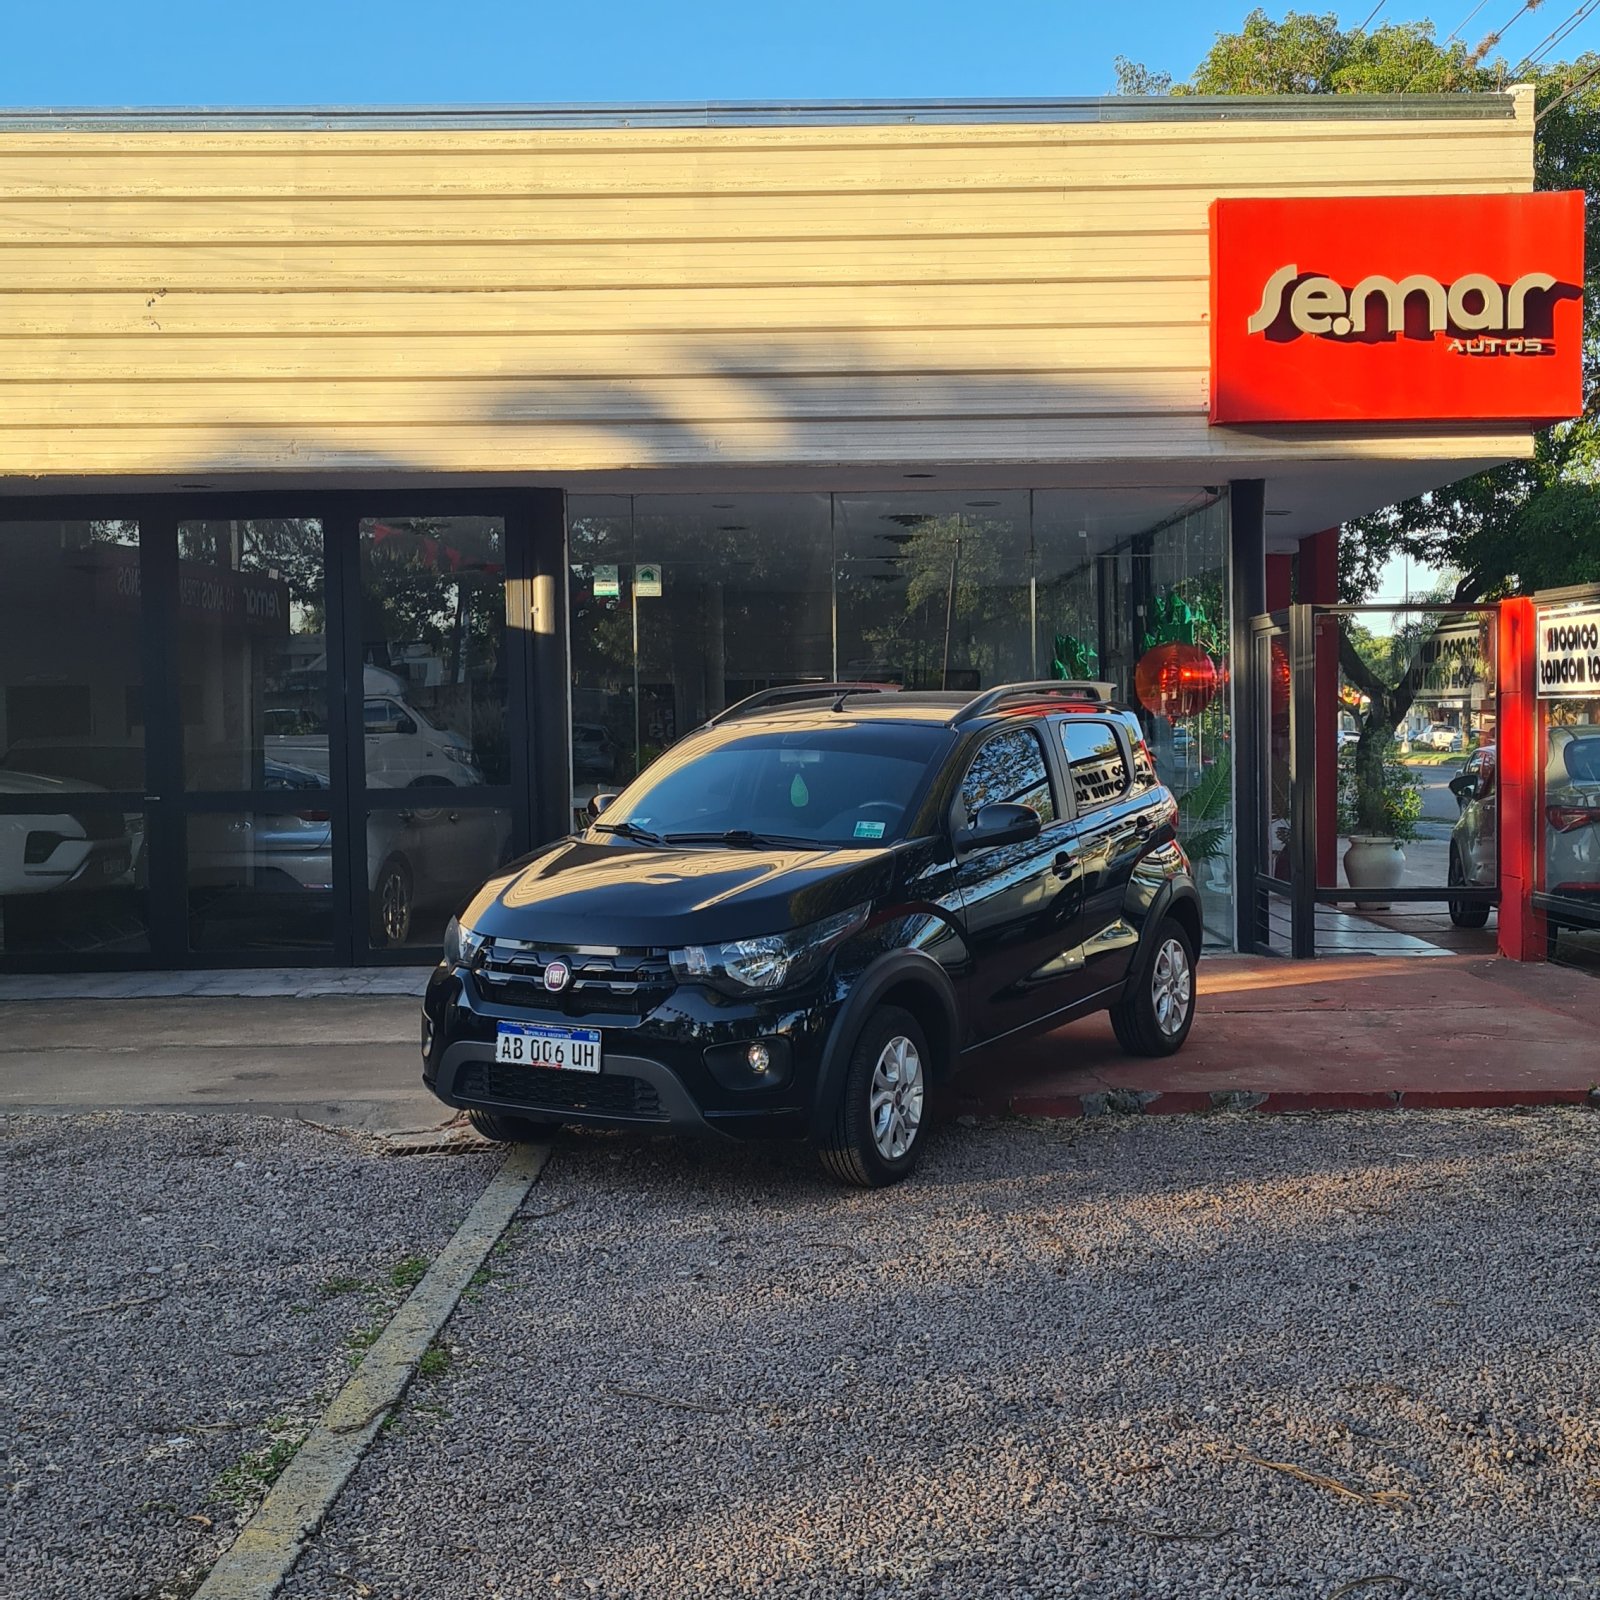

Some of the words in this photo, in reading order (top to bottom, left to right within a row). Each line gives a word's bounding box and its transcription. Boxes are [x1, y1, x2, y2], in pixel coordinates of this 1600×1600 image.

[1447, 338, 1543, 354] AUTOS
[548, 970, 565, 984] FIAT
[502, 1036, 524, 1060] AB
[530, 1039, 565, 1064] 006
[572, 1043, 595, 1068] UH
